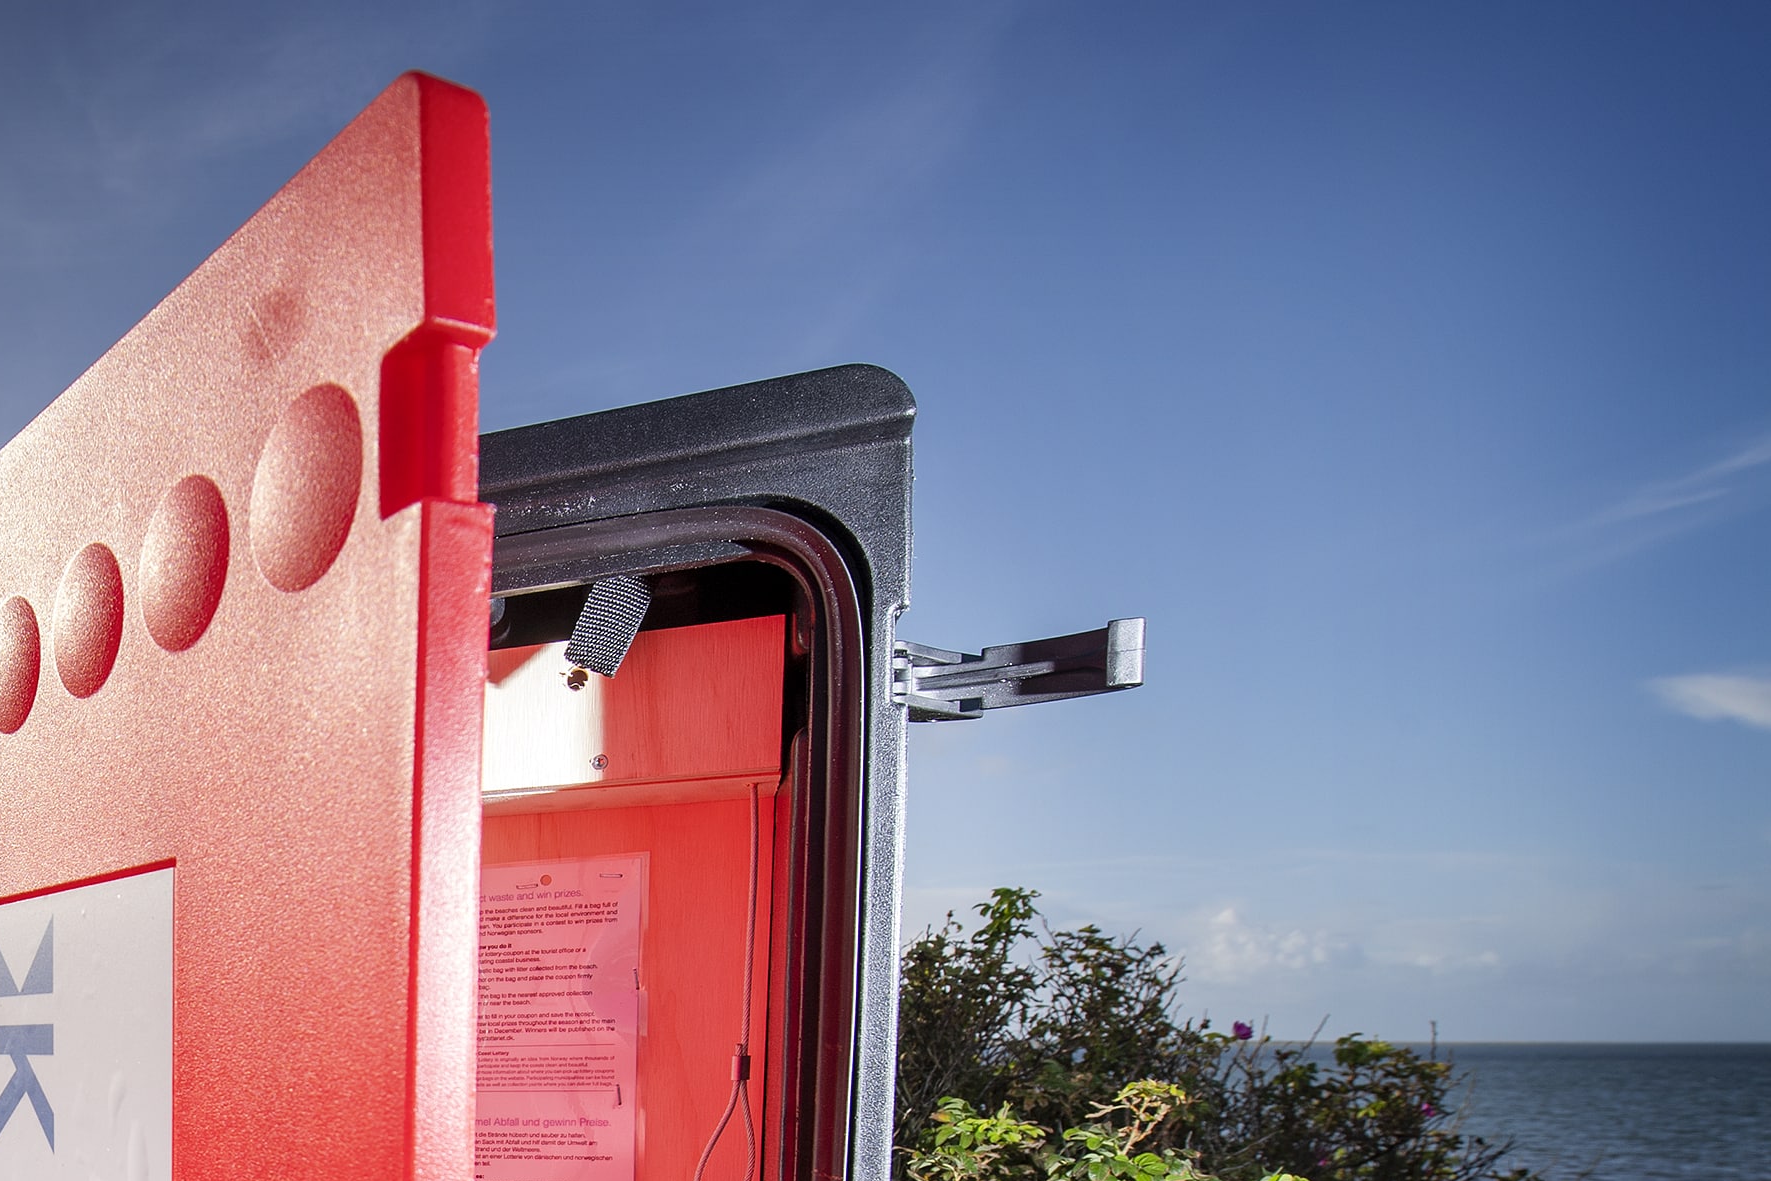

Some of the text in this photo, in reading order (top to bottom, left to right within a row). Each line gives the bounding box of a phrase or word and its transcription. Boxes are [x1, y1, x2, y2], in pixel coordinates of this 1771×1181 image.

[489, 892, 515, 902] waste
[517, 891, 534, 900] and
[536, 890, 552, 899] win
[554, 888, 583, 900] prizes.
